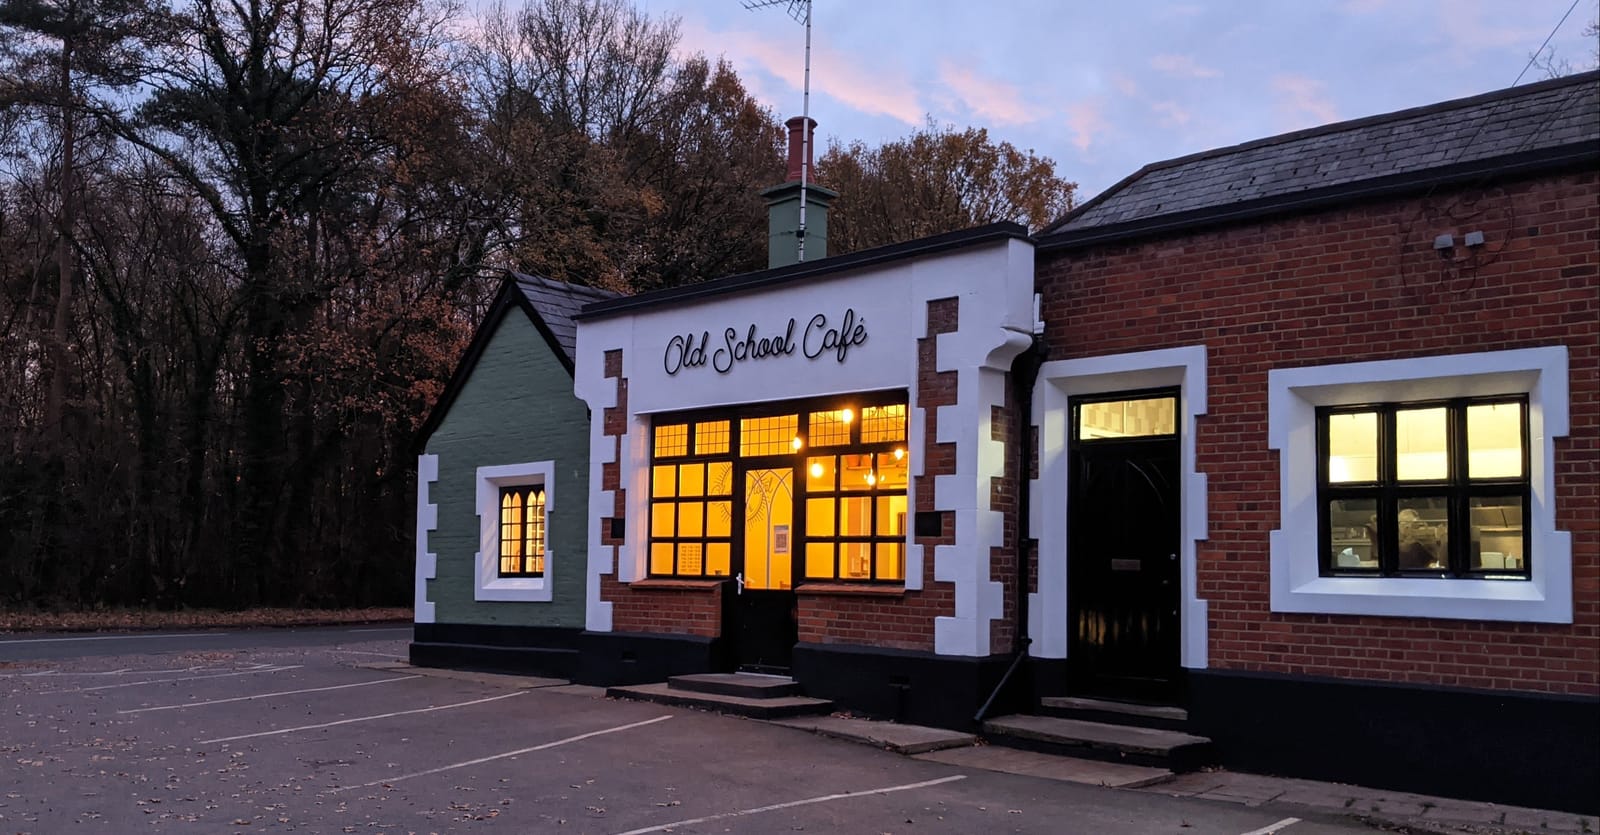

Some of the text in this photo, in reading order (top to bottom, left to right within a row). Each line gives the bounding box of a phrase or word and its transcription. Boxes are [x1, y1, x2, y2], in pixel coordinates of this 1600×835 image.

[664, 308, 868, 375] Old School Café
